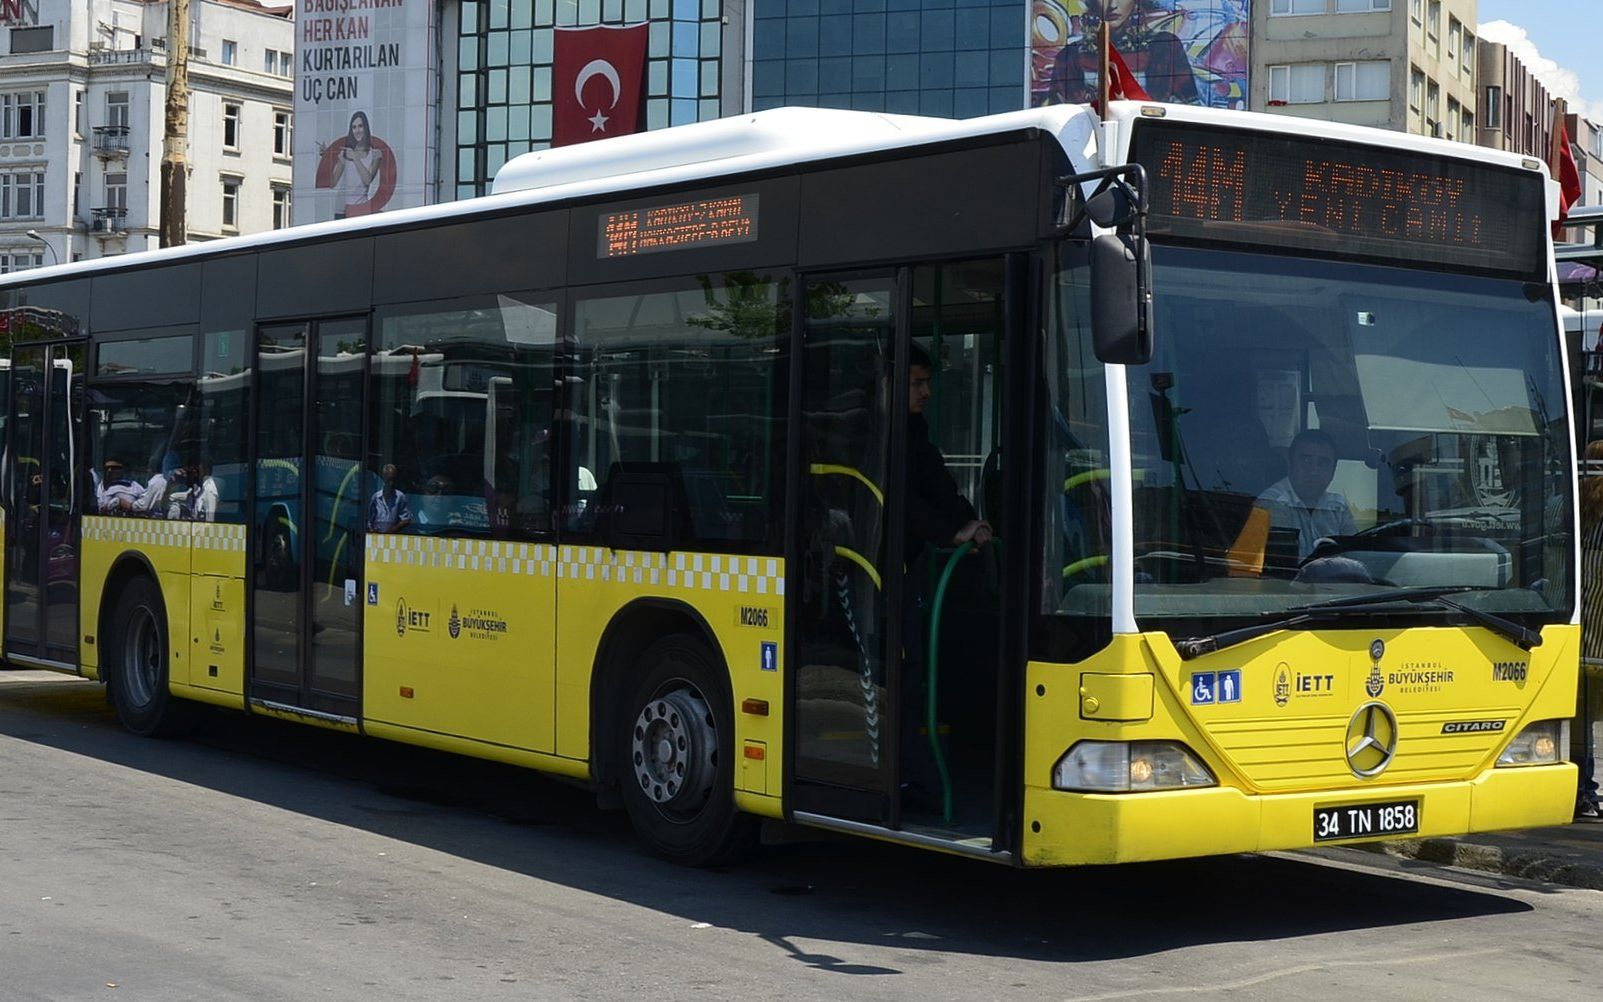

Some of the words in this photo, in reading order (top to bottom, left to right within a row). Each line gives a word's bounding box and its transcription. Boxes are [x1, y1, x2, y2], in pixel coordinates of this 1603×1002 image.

[304, 0, 403, 13] BAIŞL
[303, 18, 332, 42] HER
[336, 16, 369, 40] KAN
[303, 43, 400, 72] KURTARILAN
[303, 75, 322, 104] ÜÇ
[326, 76, 358, 100] CAN
[1160, 142, 1245, 222] 14M
[740, 606, 768, 628] M2066
[1296, 672, 1334, 692] İETT
[1388, 667, 1454, 687] BÜYÜKŞEHİR
[1492, 661, 1527, 682] M2066
[1443, 720, 1504, 734] CITARO
[1318, 812, 1340, 837] 34
[1347, 808, 1372, 834] TN
[1378, 804, 1415, 832] 1858
